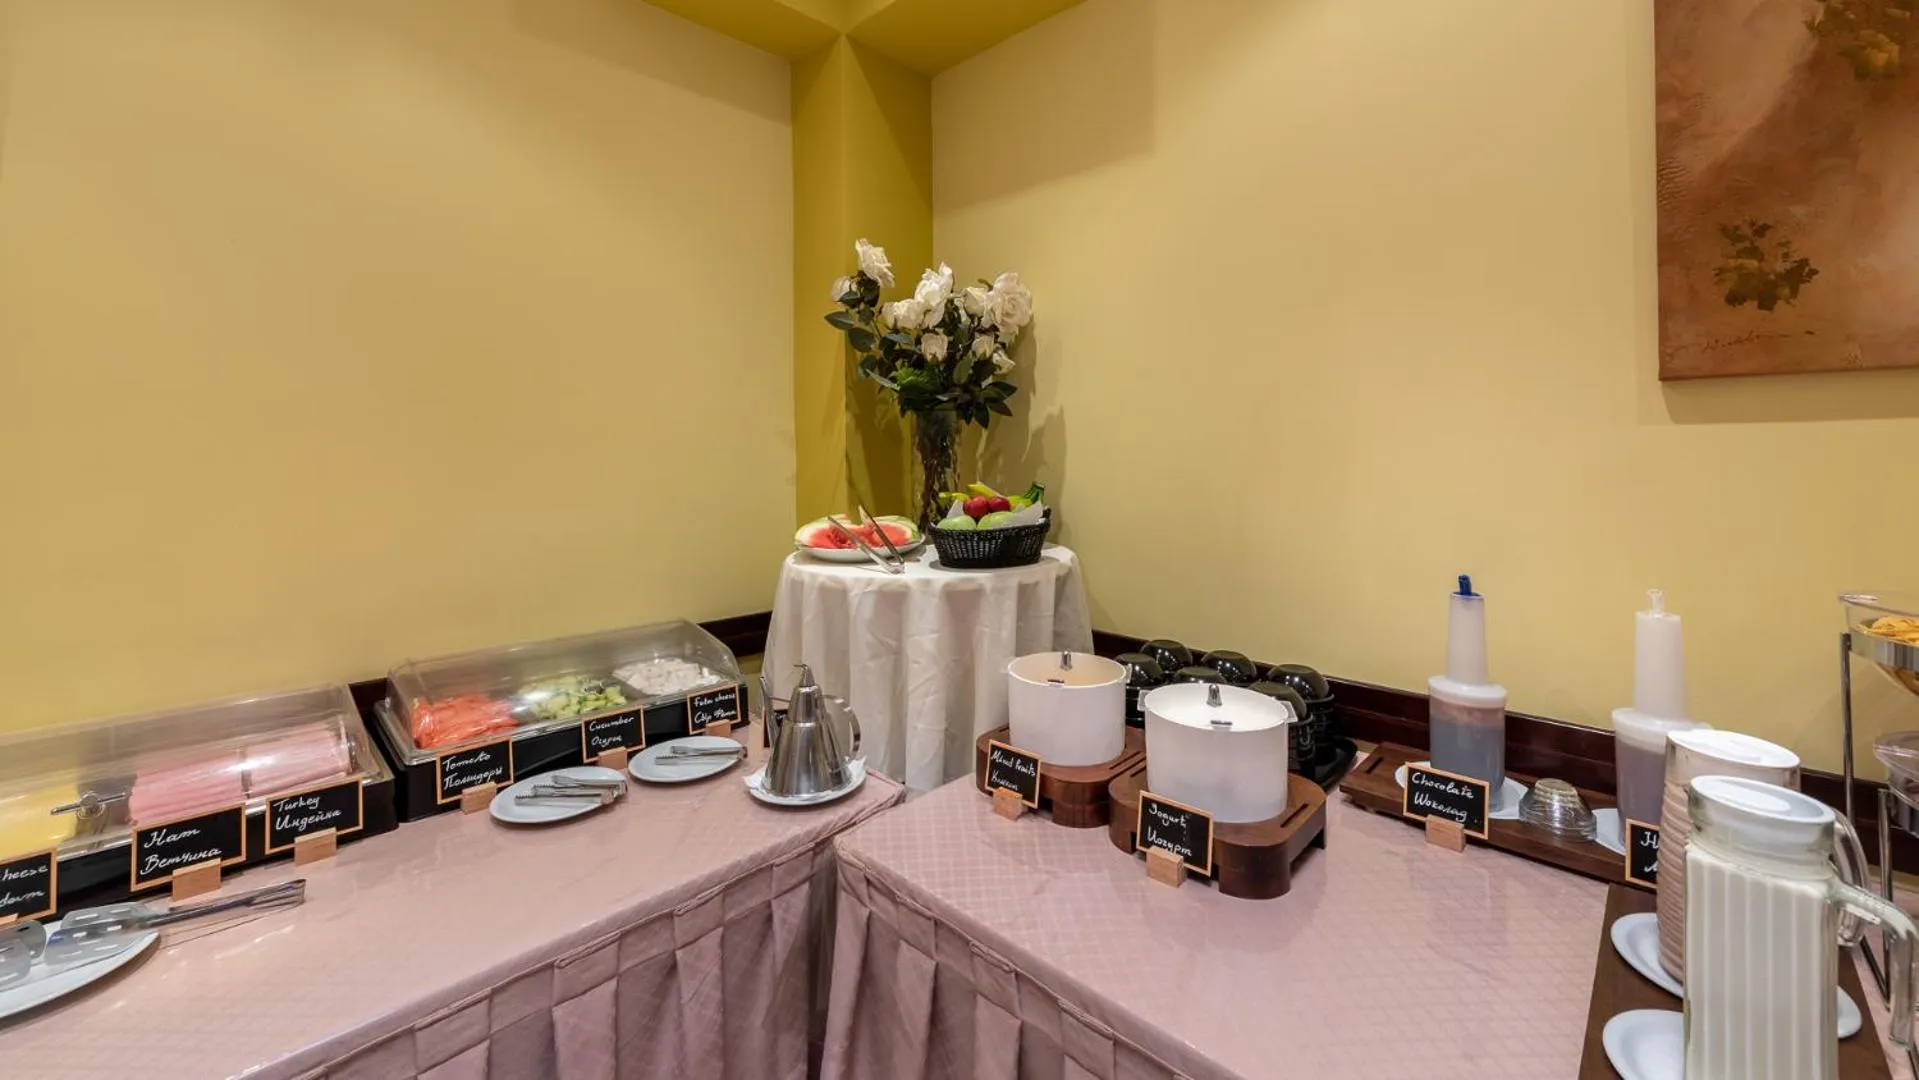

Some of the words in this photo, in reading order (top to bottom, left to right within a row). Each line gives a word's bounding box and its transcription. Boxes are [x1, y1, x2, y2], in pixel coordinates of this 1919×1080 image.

[589, 715, 634, 731] Cucumber
[1411, 772, 1475, 800] Chocolate
[273, 794, 320, 811] Turkey
[1413, 791, 1468, 823] Шоколад
[275, 808, 344, 832] Индейка
[143, 827, 201, 848] Ham
[0, 864, 49, 881] heese
[140, 847, 223, 876] Ветчина
